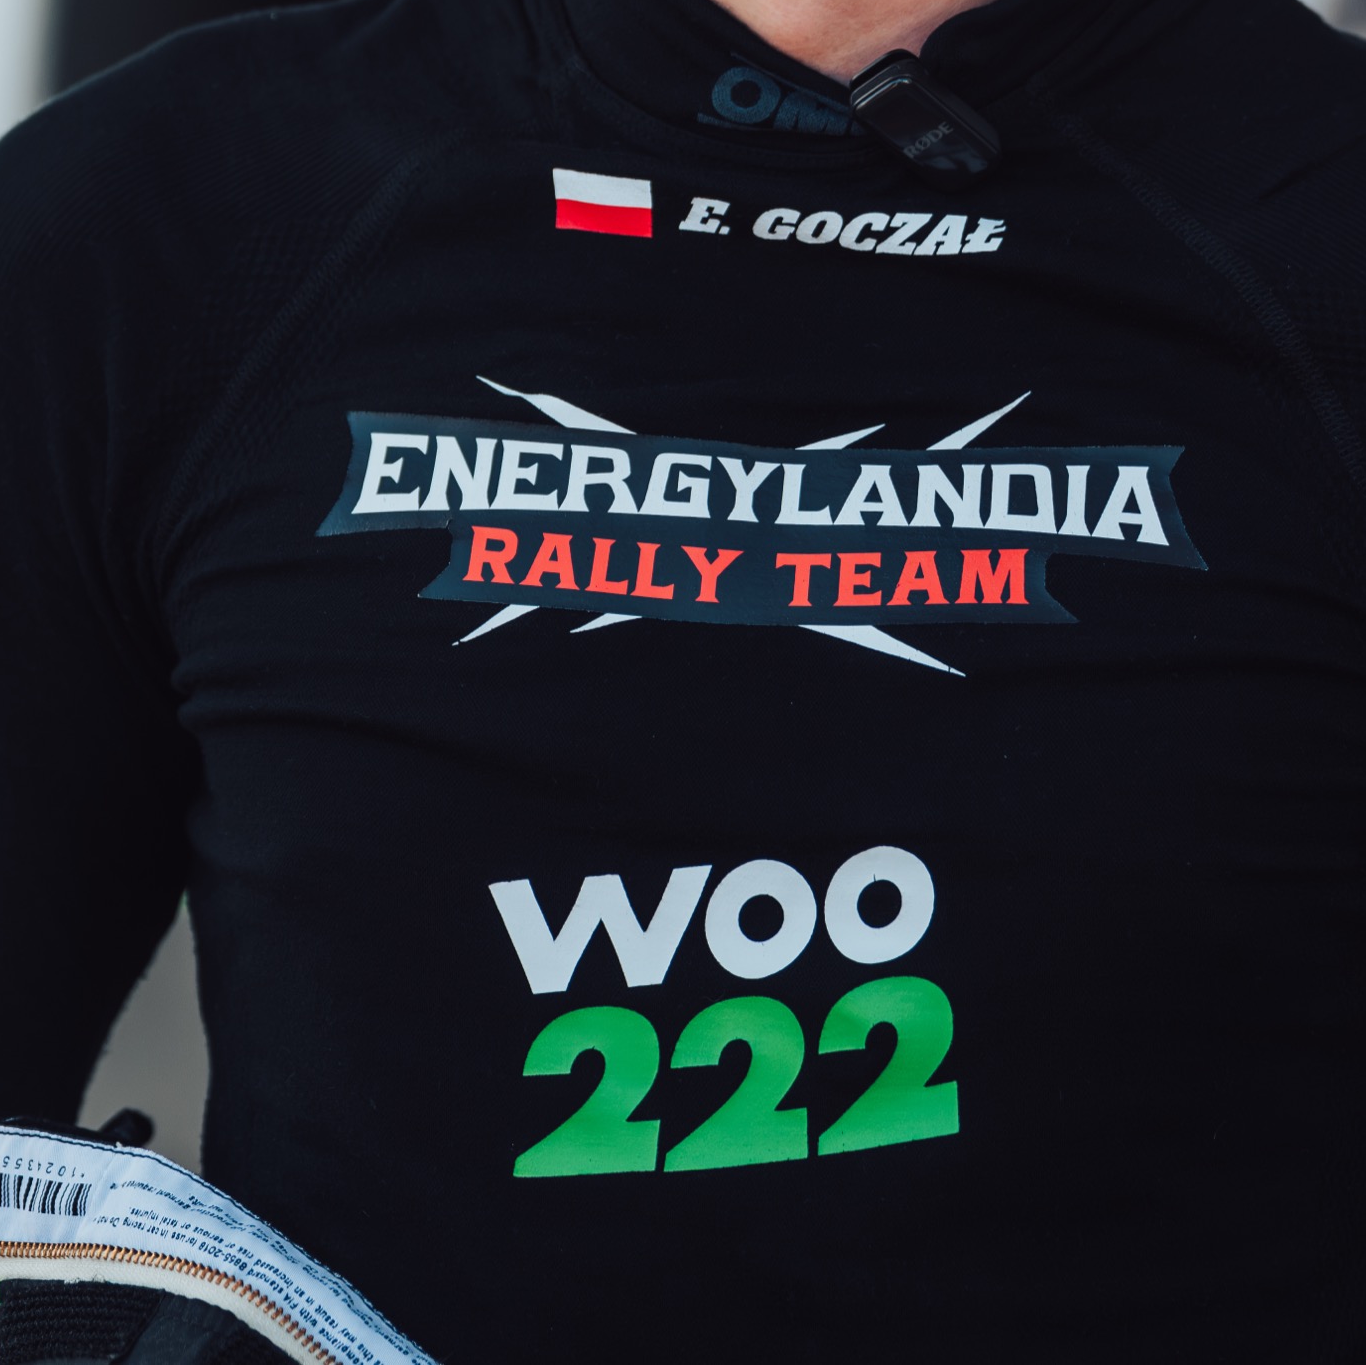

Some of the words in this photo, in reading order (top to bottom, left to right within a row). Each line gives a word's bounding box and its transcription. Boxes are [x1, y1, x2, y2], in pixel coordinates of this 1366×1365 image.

[711, 66, 864, 135] OM
[679, 197, 730, 235] E.
[752, 208, 1006, 256] GOCZAŁ
[351, 432, 1170, 546] ENERGYLANDIA
[462, 526, 743, 603] RALLY
[776, 549, 1030, 607] TEAM
[488, 845, 935, 994] WOO
[513, 976, 959, 1177] 222
